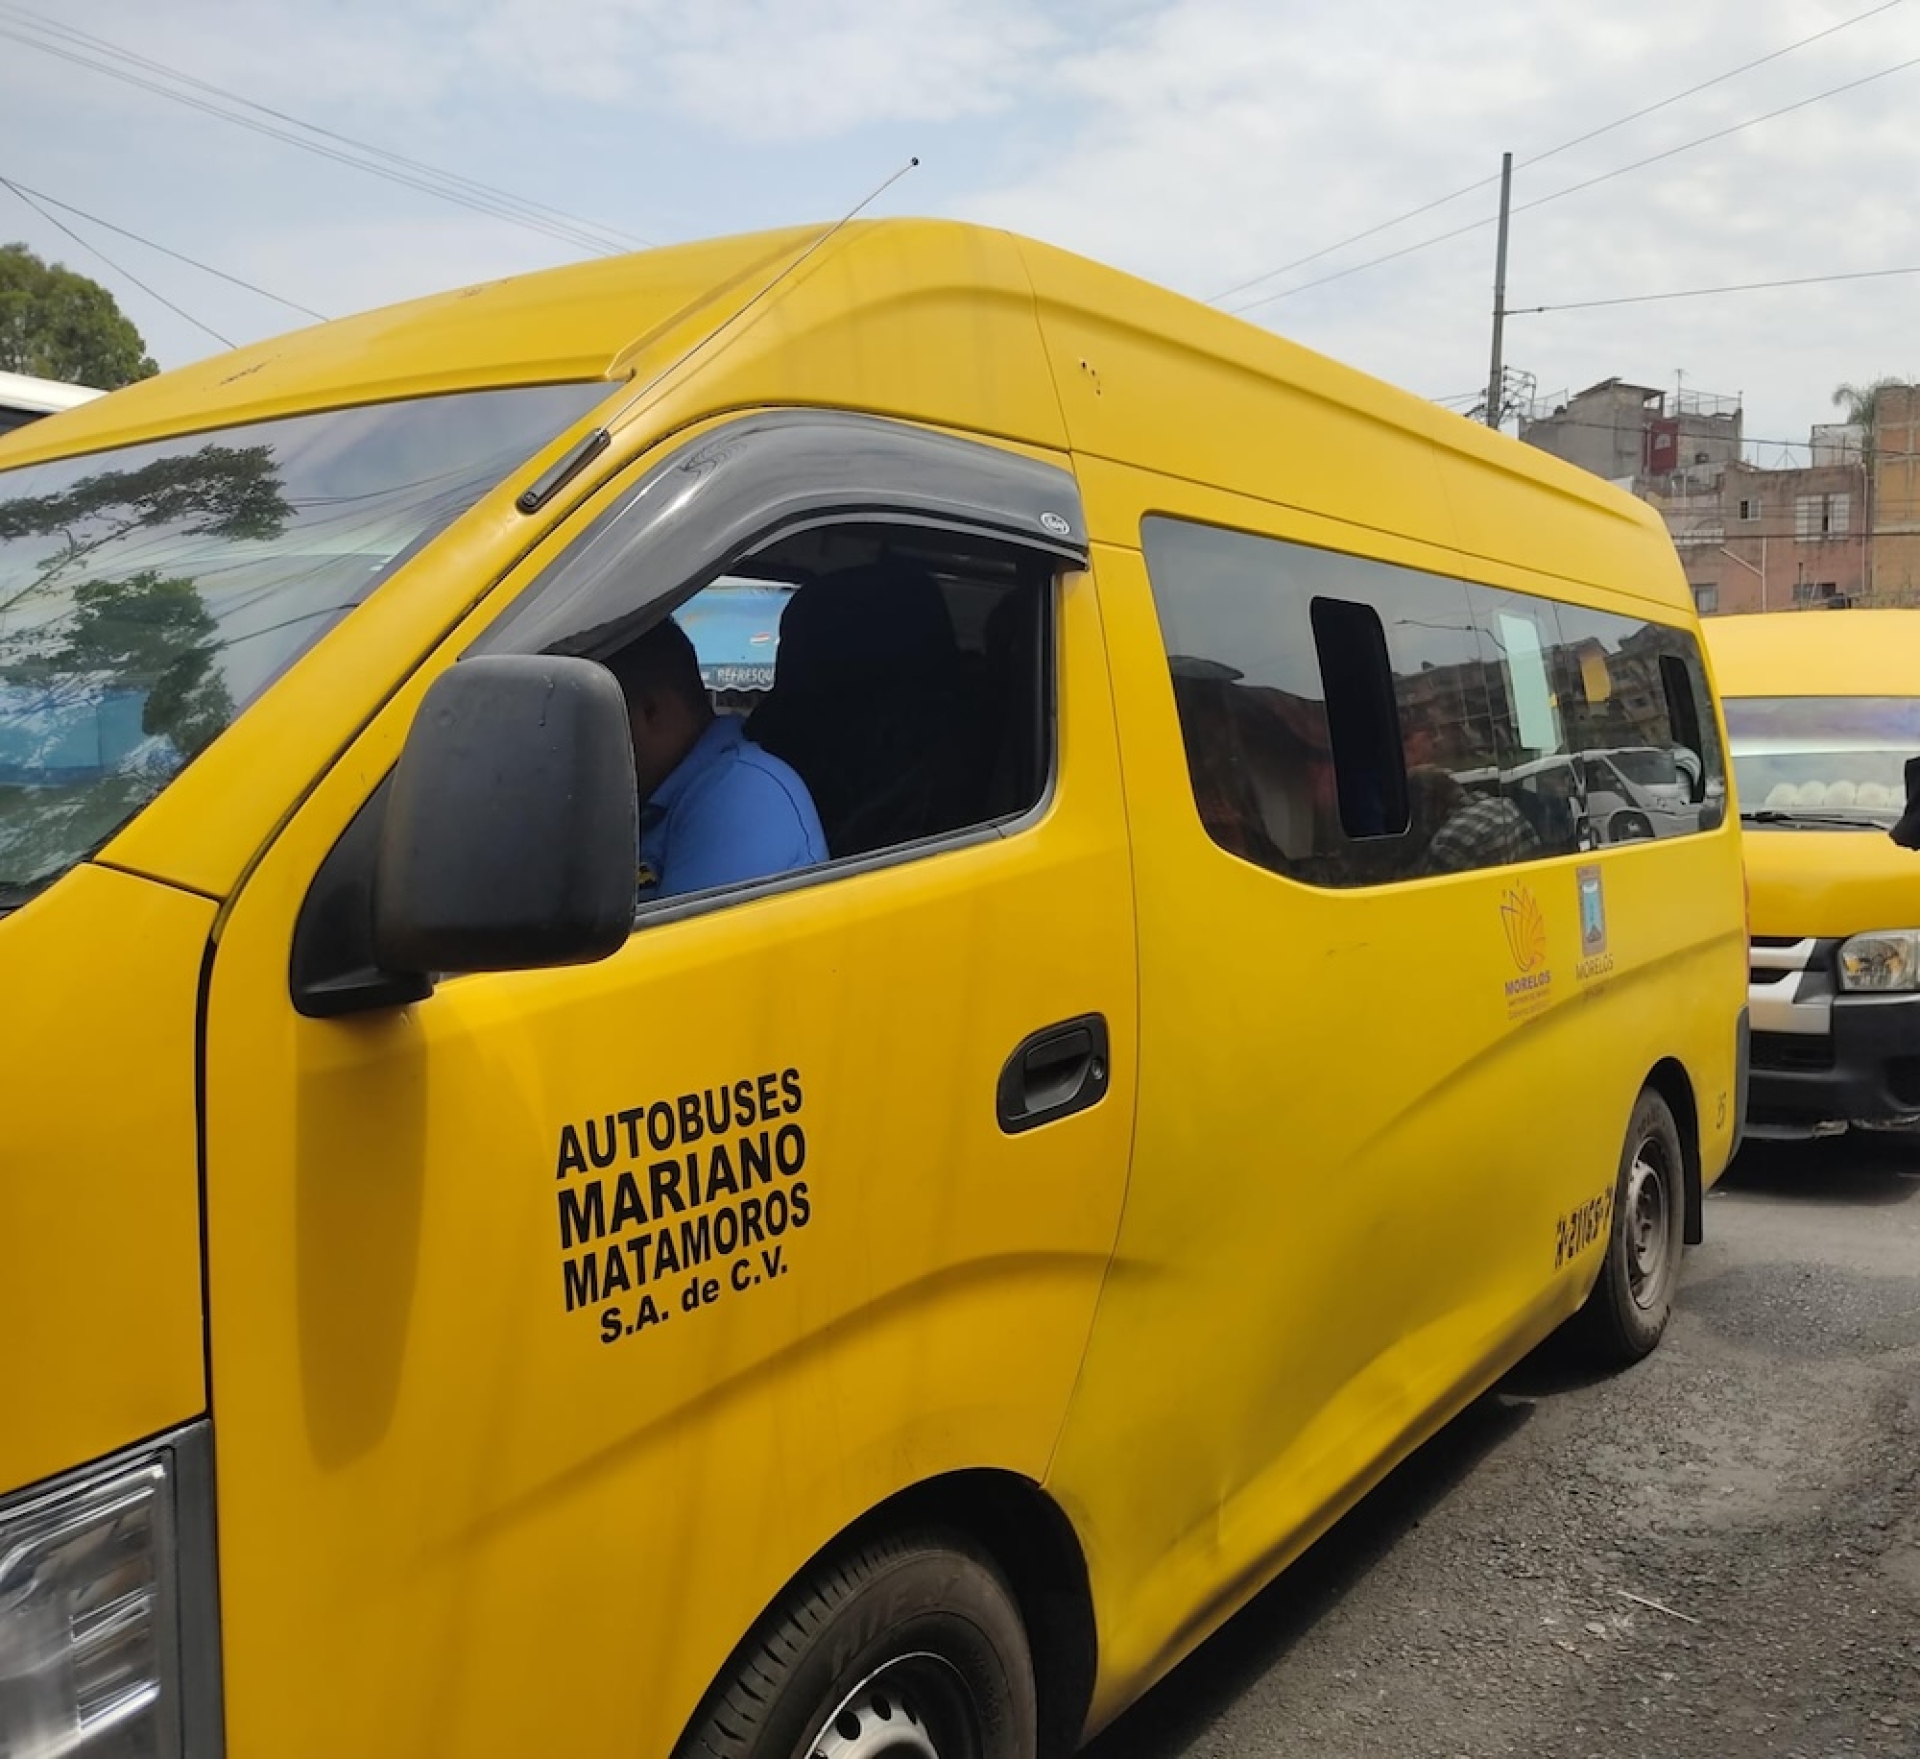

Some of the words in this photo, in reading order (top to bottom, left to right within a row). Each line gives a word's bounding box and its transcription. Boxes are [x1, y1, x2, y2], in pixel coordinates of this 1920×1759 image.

[1505, 970, 1551, 996] MORELOS
[1575, 953, 1614, 980] MORELOS
[556, 1068, 802, 1180] AUTOBUSES
[558, 1123, 806, 1249] MARIANO
[563, 1182, 810, 1312] MATAMOROS
[600, 1295, 669, 1344] S.A.
[681, 1277, 720, 1312] de
[731, 1245, 788, 1291] C.V.
